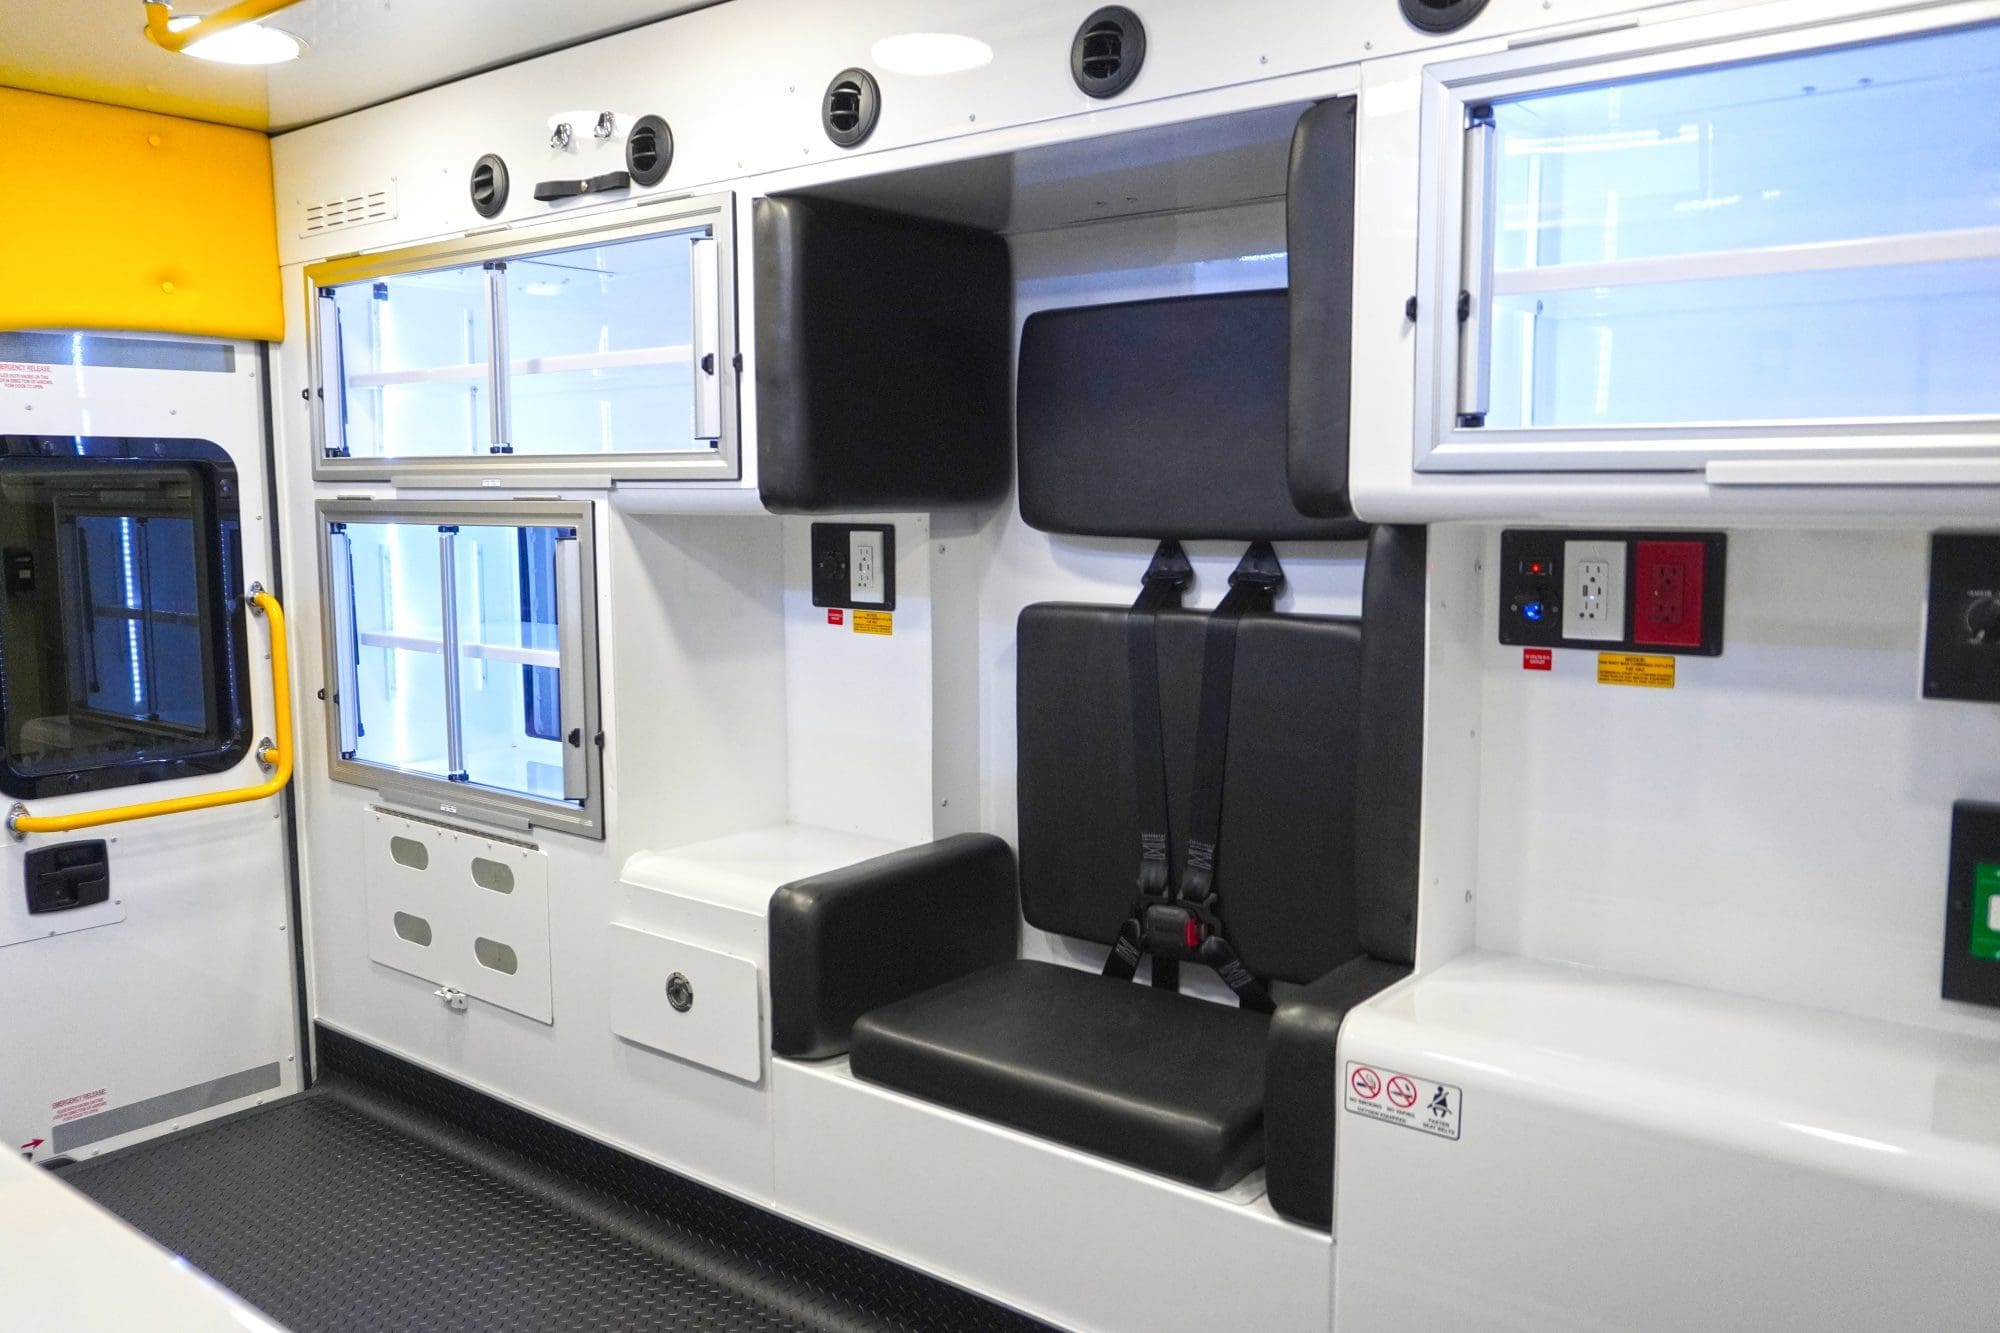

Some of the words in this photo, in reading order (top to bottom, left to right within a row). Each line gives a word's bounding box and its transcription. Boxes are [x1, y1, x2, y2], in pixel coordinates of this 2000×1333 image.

[1358, 1099, 1382, 1109] SMOKING
[1428, 1118, 1450, 1128] FASTEN
[1422, 1122, 1436, 1131] SEAT
[1437, 1126, 1455, 1136] BELTS
